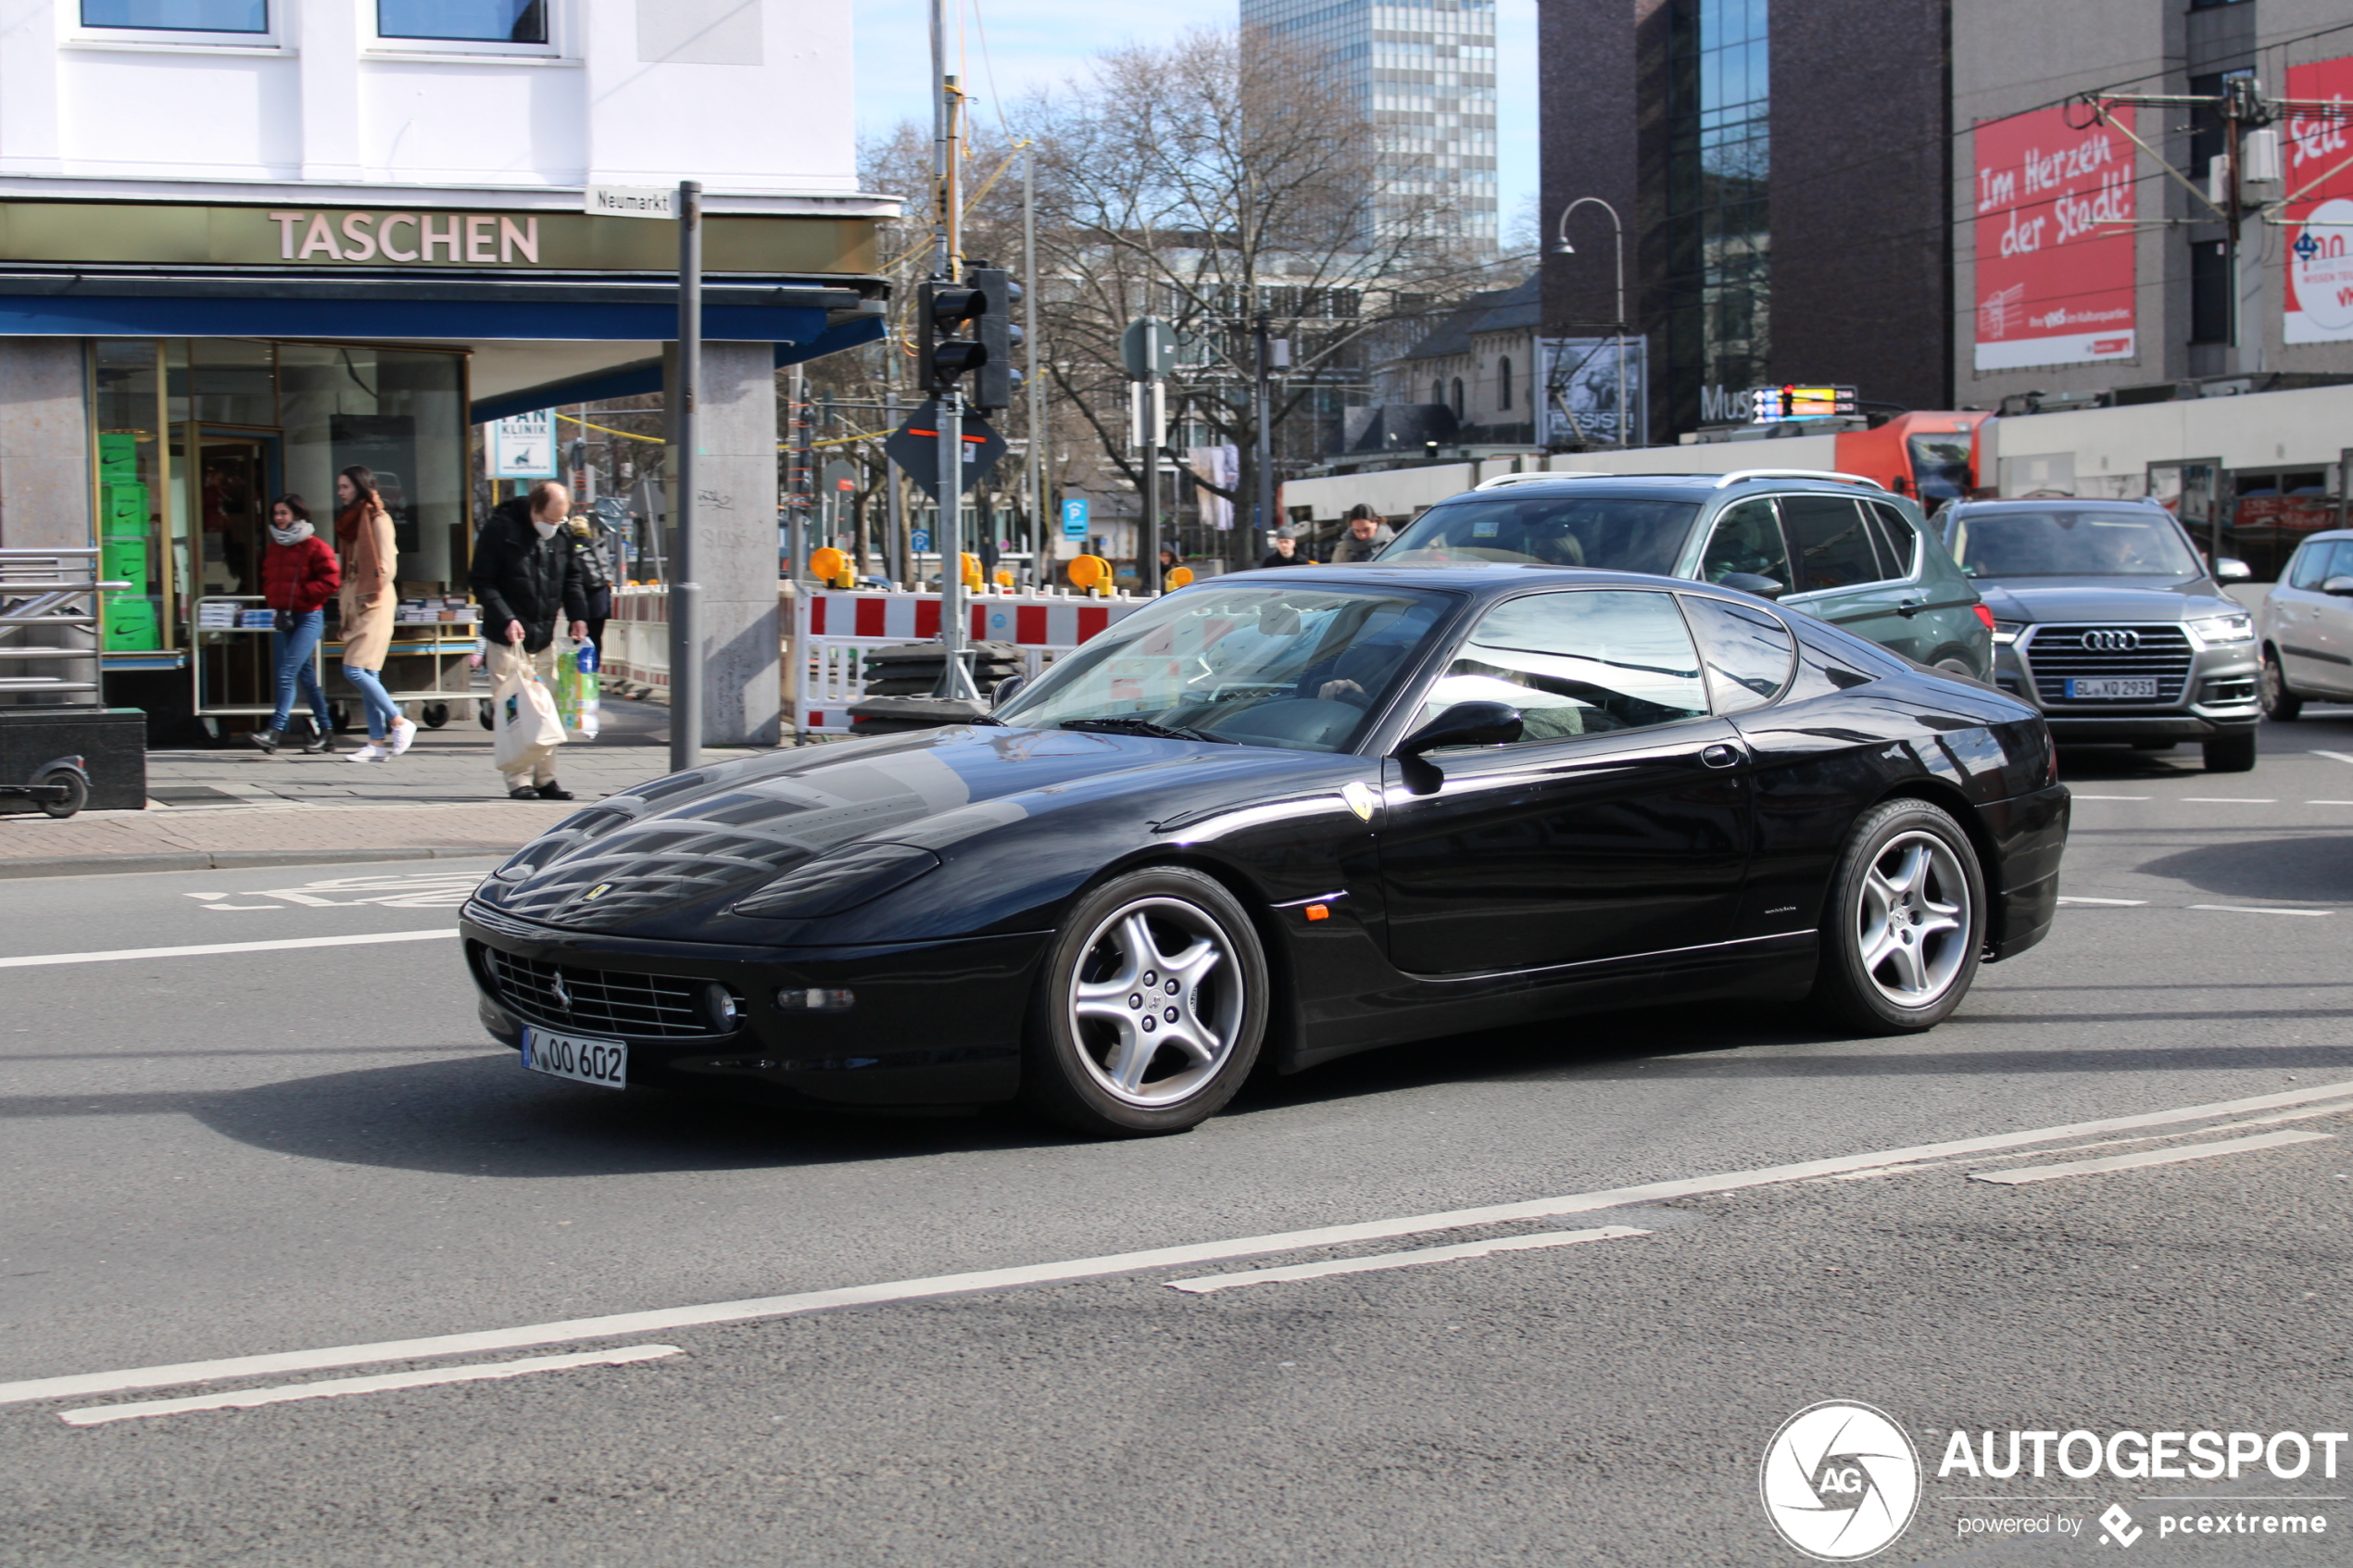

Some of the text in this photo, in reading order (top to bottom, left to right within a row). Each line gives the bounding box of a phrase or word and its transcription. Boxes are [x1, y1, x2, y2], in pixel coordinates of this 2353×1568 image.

[2290, 93, 2347, 169] Seit
[1978, 133, 2112, 212] Im Herzen
[598, 190, 669, 212] Neumarkt
[2000, 164, 2130, 258] der Stadt!
[269, 211, 539, 265] TASCHEN
[501, 425, 547, 434] KLINIK
[502, 410, 546, 423] AN
[2075, 681, 2092, 696] GL
[2121, 681, 2155, 696] 2931
[529, 1031, 539, 1066] K
[579, 1044, 622, 1083] 602
